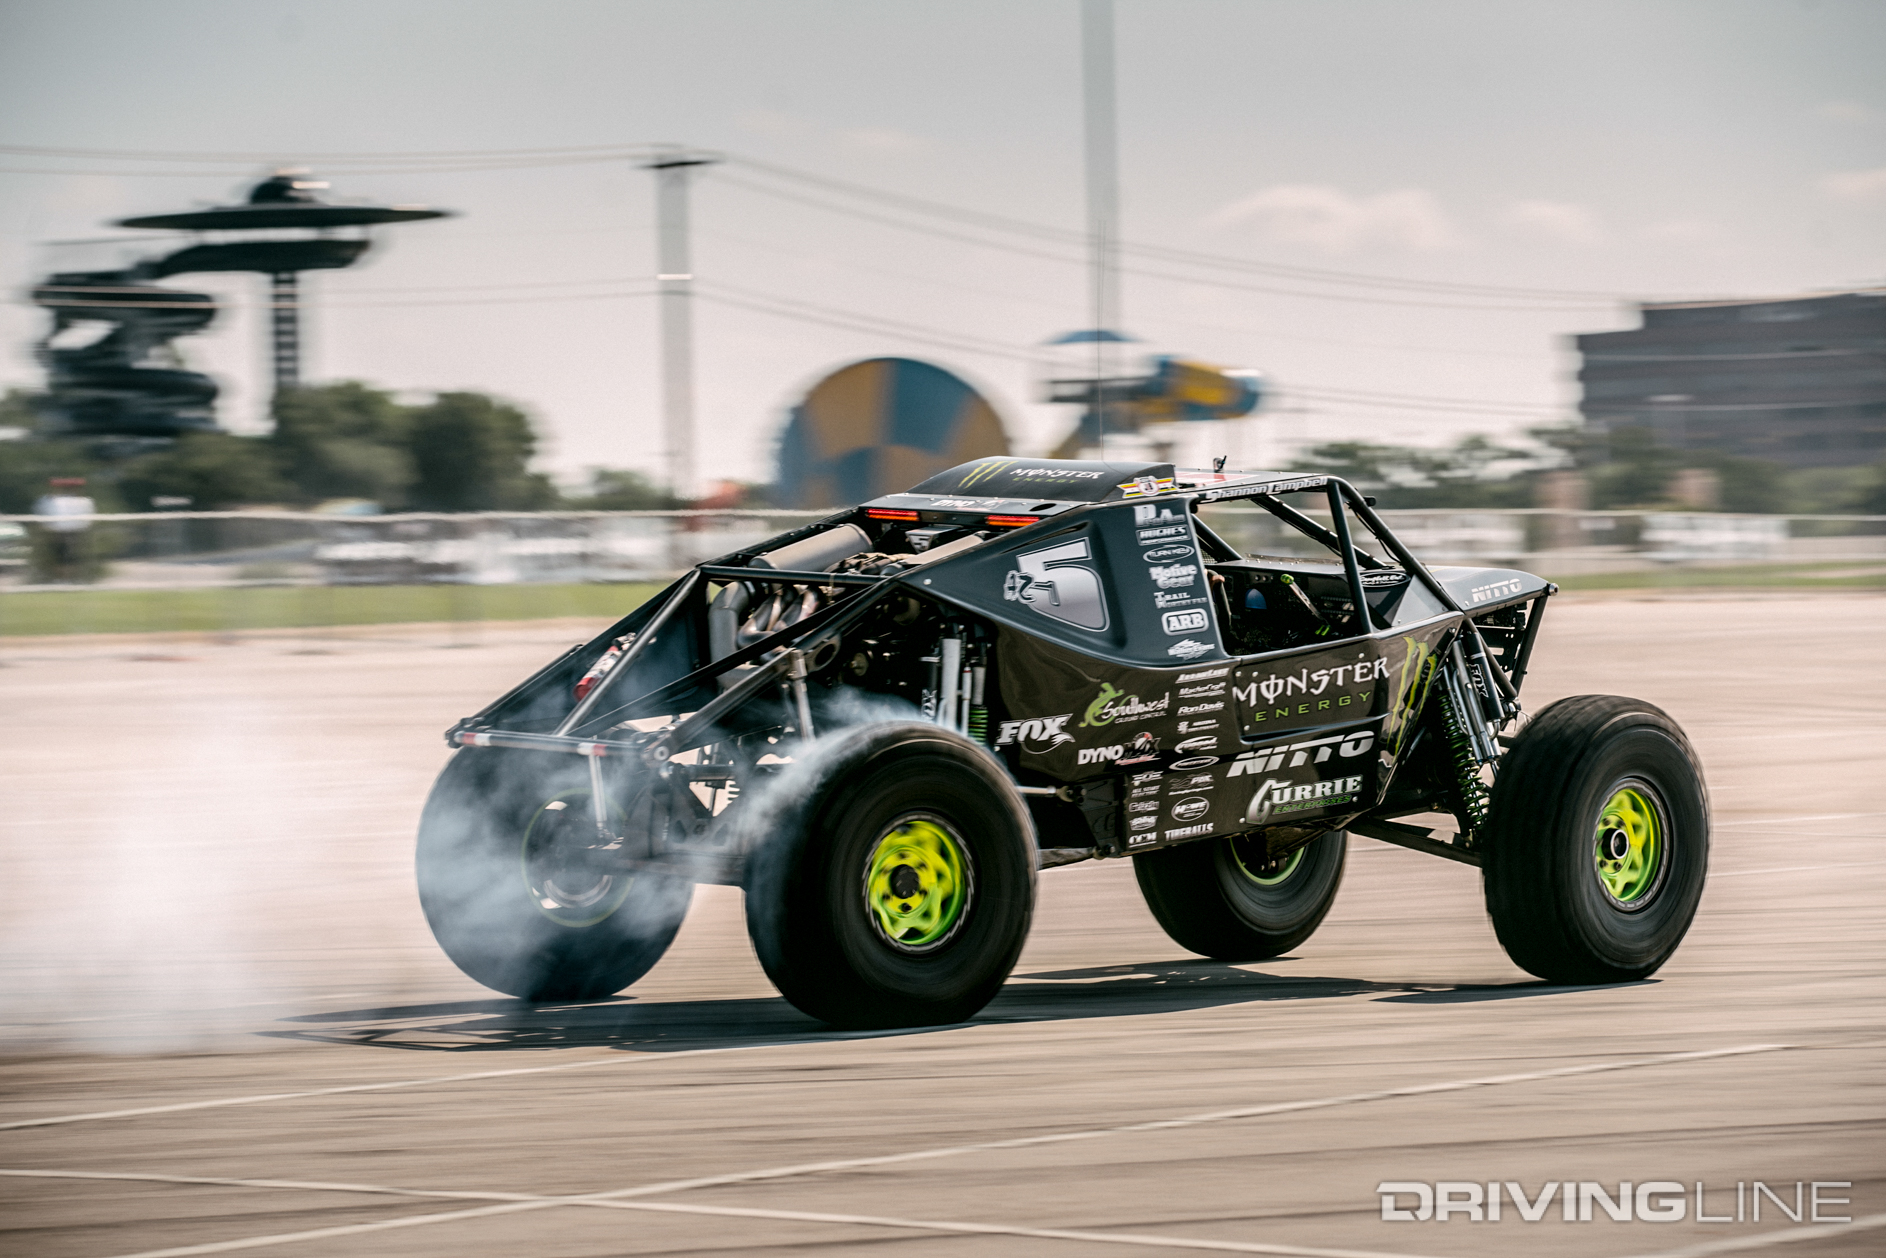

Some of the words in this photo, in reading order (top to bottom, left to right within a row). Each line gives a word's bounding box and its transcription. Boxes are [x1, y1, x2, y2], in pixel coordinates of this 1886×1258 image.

[1009, 468, 1105, 479] MONSTER
[1201, 485, 1267, 502] Shannon
[1266, 478, 1328, 495] Campbell
[909, 534, 930, 551] 5
[1140, 526, 1186, 538] HUGHES
[1016, 536, 1110, 632] 5
[1471, 578, 1523, 602] NITTO
[1168, 613, 1205, 631] ARB
[1232, 656, 1391, 708] MONSTER
[1469, 663, 1489, 698] FOX
[1101, 691, 1170, 719] Southwest
[1178, 706, 1199, 715] Ron
[1199, 701, 1225, 712] Davis
[1254, 691, 1371, 722] ENERGY
[995, 713, 1076, 747] FOX
[1078, 744, 1124, 765] DYNO
[1226, 730, 1375, 778] NITTO
[1245, 774, 1363, 825] CURRIE
[1272, 794, 1351, 814] ENTERPRISES
[1164, 822, 1214, 841] TIREBALLS
